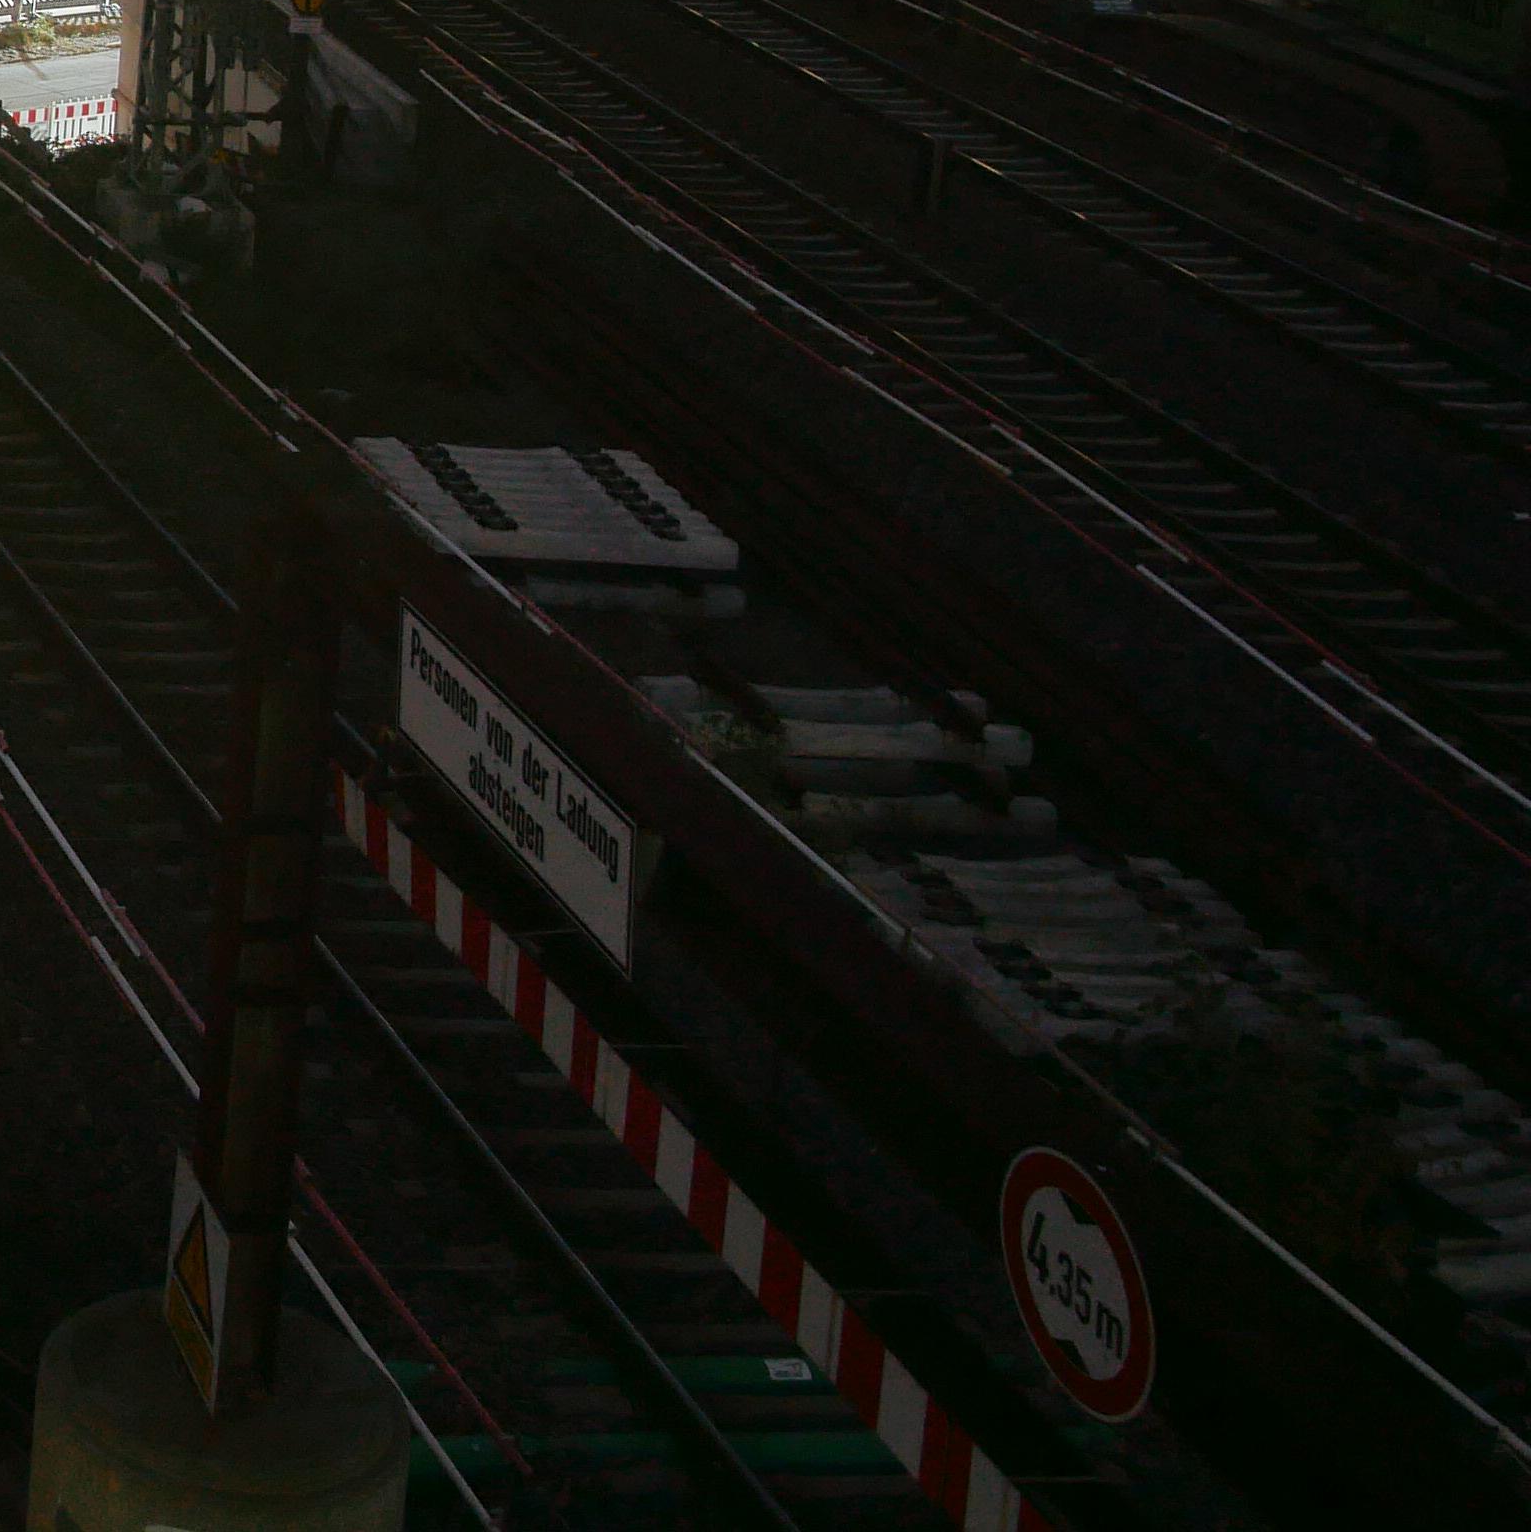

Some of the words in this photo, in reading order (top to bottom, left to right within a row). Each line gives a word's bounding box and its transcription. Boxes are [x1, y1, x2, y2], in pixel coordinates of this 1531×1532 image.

[410, 627, 478, 733] Personen
[485, 708, 513, 768] von
[521, 741, 549, 803] der
[556, 769, 620, 884] Ladung
[468, 752, 545, 863] absteigen
[1096, 1301, 1122, 1360] m
